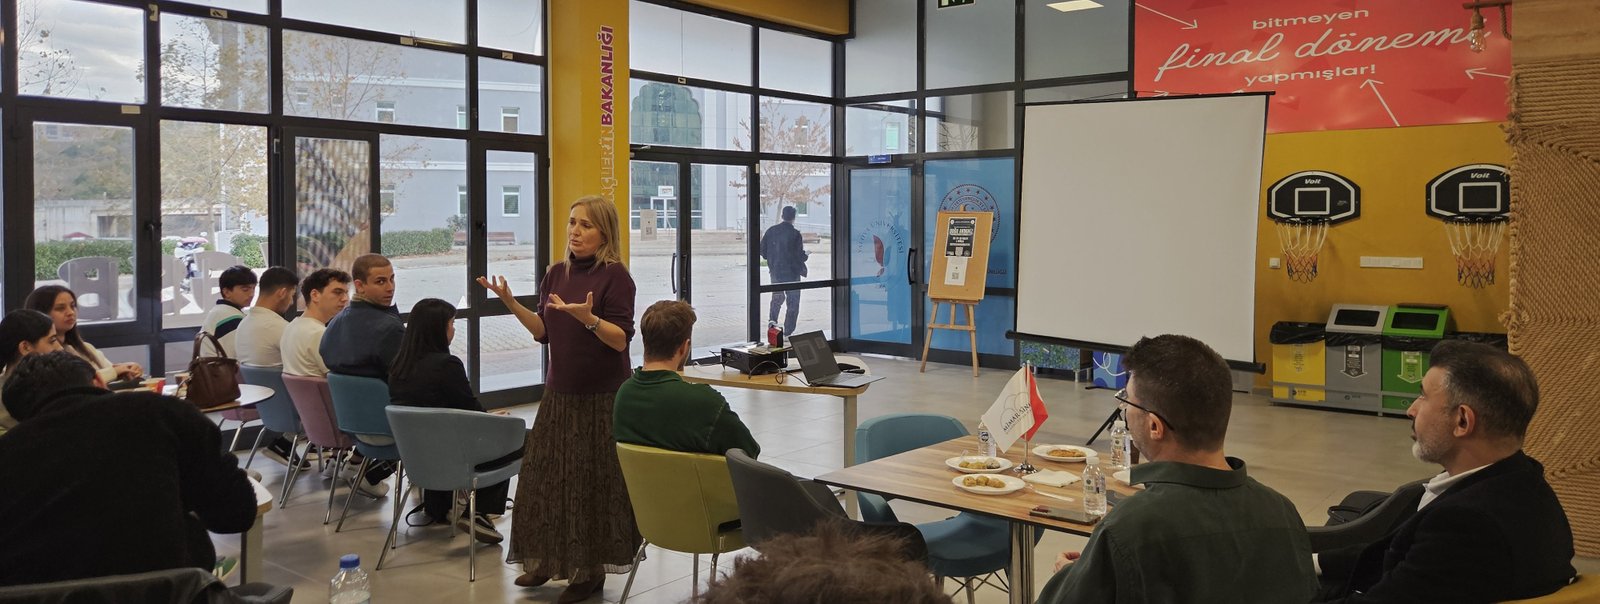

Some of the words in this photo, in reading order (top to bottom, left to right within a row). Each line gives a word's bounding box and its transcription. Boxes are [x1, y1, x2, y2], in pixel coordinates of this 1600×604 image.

[1252, 9, 1369, 30] bitmeyen
[597, 26, 614, 126] BAKANLIĞI
[1154, 33, 1285, 82] final
[1244, 64, 1376, 87] yapmışlar!
[599, 126, 618, 201] NÇLERİN
